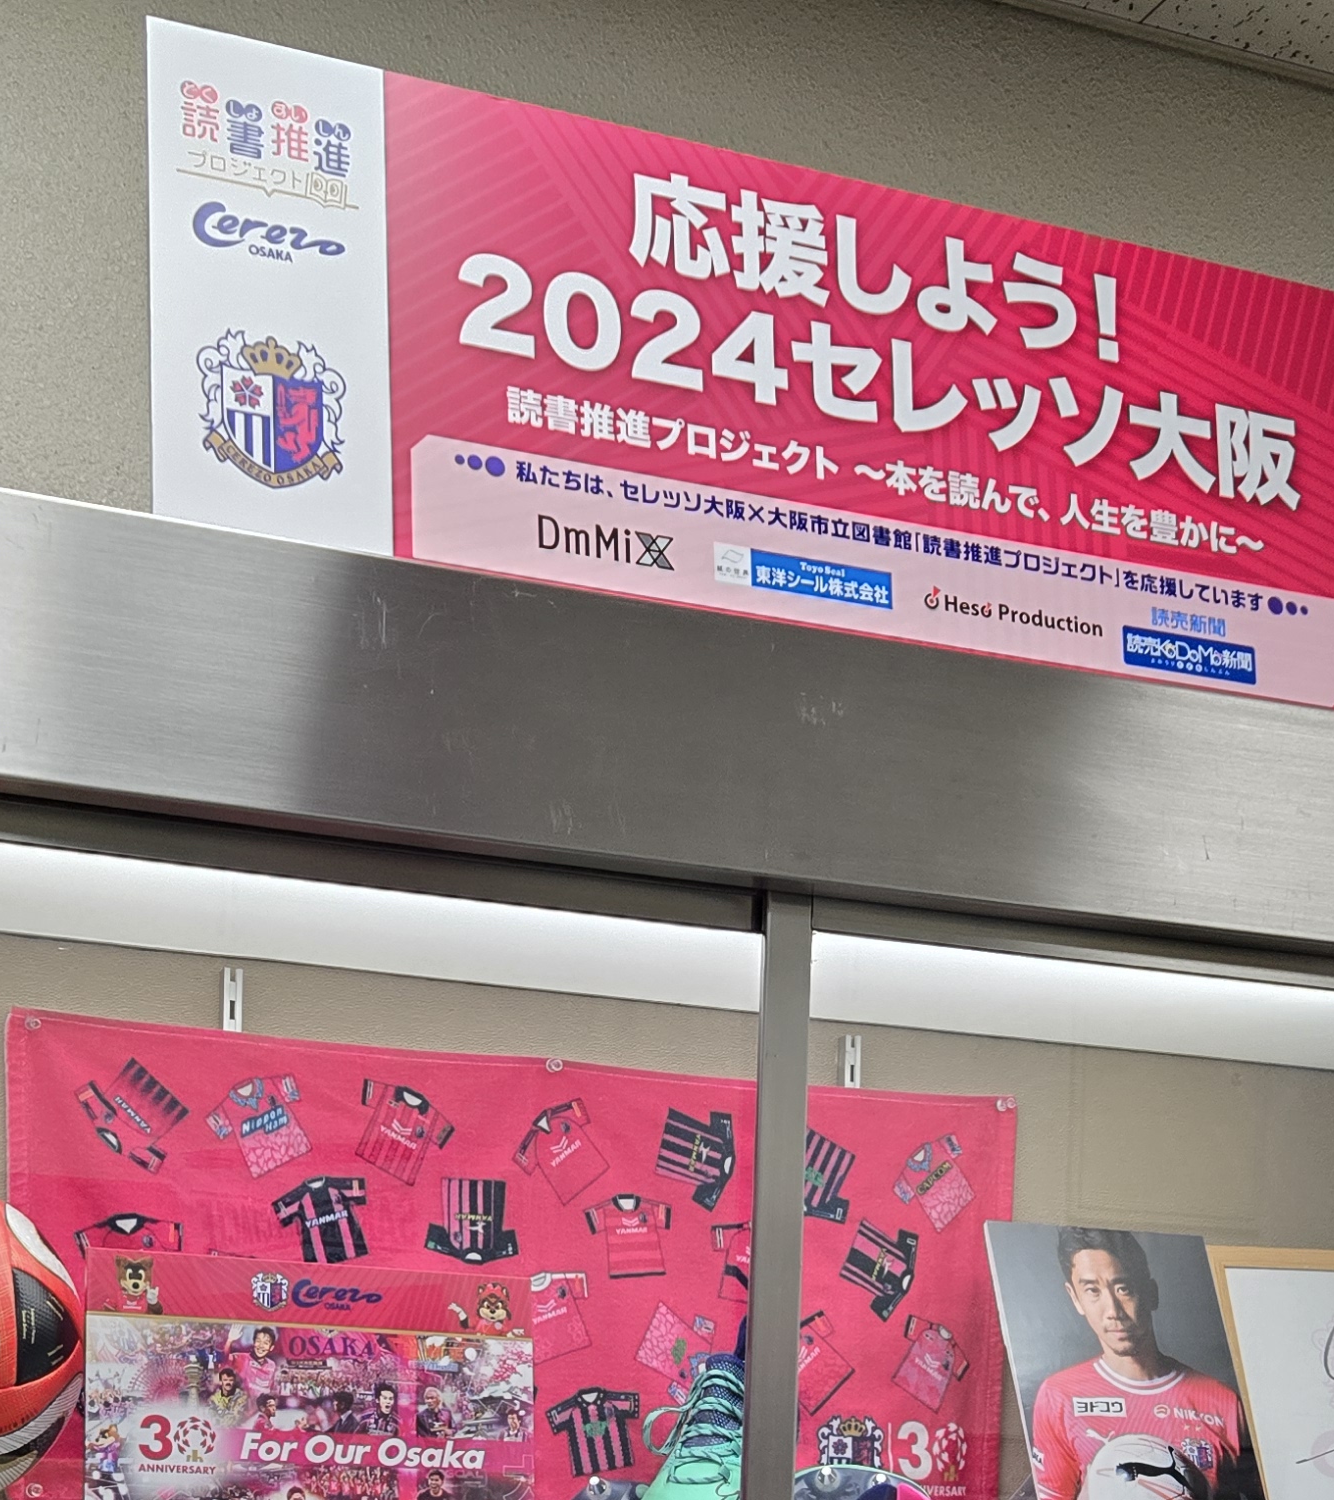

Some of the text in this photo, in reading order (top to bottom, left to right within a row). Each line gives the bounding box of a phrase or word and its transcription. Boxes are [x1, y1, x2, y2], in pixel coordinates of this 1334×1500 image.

[180, 101, 351, 178] 読書推進
[187, 150, 303, 189] プロジェクト
[192, 201, 346, 256] Cerezo
[248, 244, 294, 263] OSAKA
[457, 252, 1302, 511] 2024セレッソ大阪
[505, 385, 839, 480] 読書推進プロジェクト
[755, 565, 889, 604] 東洋シール株式会社
[799, 561, 846, 578] Toyo Seal
[998, 604, 1104, 637] Production
[1151, 606, 1226, 637] 読売新聞
[242, 1107, 284, 1134] Nippon
[265, 1115, 288, 1134] Ham
[379, 1124, 418, 1150] YANMAR
[549, 1139, 582, 1168] YANMAR
[917, 1161, 953, 1196] CAPCOM
[305, 1210, 349, 1229] YANMAR
[615, 1226, 648, 1236] YANMAR
[292, 1279, 383, 1309] Cerezo
[1076, 1400, 1124, 1414] ヨドコウ
[240, 1432, 485, 1470] For Our Osaka
[138, 1463, 217, 1475] ANNIVERSARY
